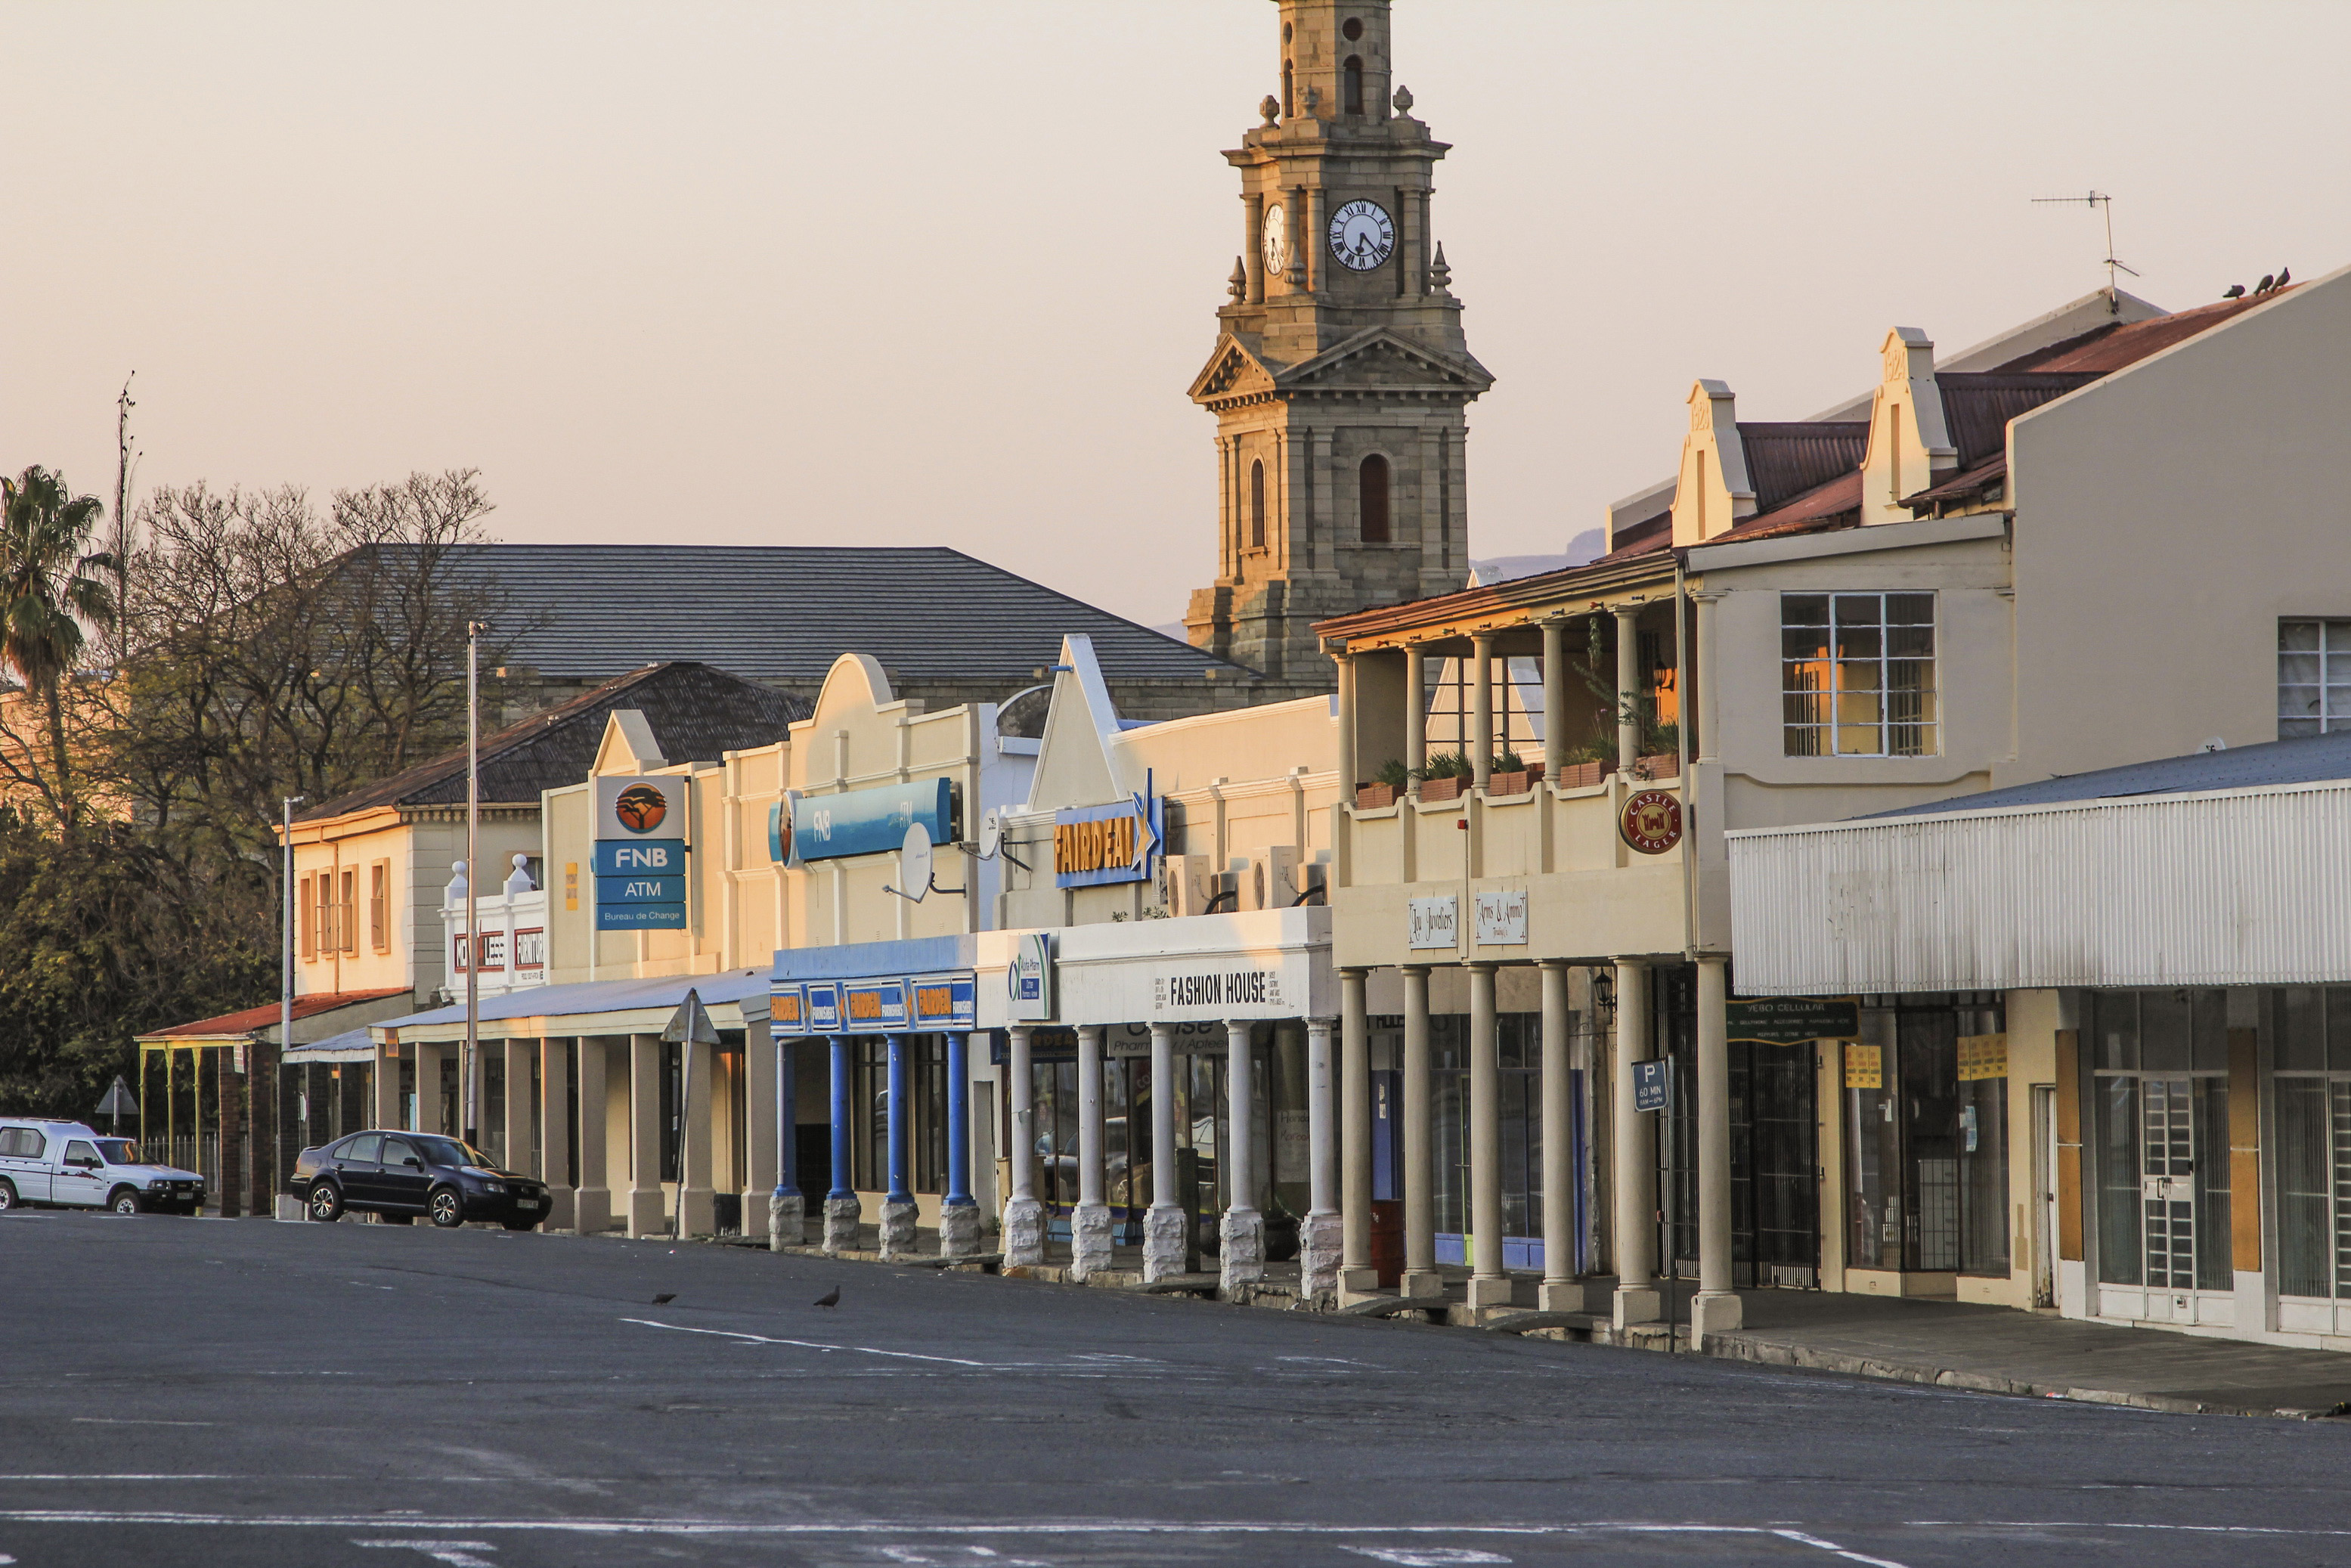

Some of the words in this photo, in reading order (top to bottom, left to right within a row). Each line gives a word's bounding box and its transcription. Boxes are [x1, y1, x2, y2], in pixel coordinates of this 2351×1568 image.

[1630, 794, 1676, 815] CASTLE
[813, 809, 832, 842] FNB
[1054, 816, 1134, 873] FAIRDEAL
[1635, 831, 1676, 848] LAGER
[615, 848, 668, 867] FNB
[624, 882, 661, 897] ATM
[649, 911, 680, 921] Change
[1496, 899, 1502, 922] &
[485, 936, 504, 965] LESS
[1171, 973, 1222, 1006] FASHION
[1226, 971, 1265, 1003] HOUSE
[850, 991, 881, 1018] FAIRDEAL
[881, 1003, 903, 1017] FURNISHERS
[918, 987, 952, 1015] FAIRDEAL
[1747, 1004, 1773, 1012] YEBO
[1777, 1003, 1825, 1012] CELLULAR
[1645, 1064, 1656, 1083] P
[1639, 1087, 1648, 1098] 60
[1649, 1084, 1662, 1095] MIN
